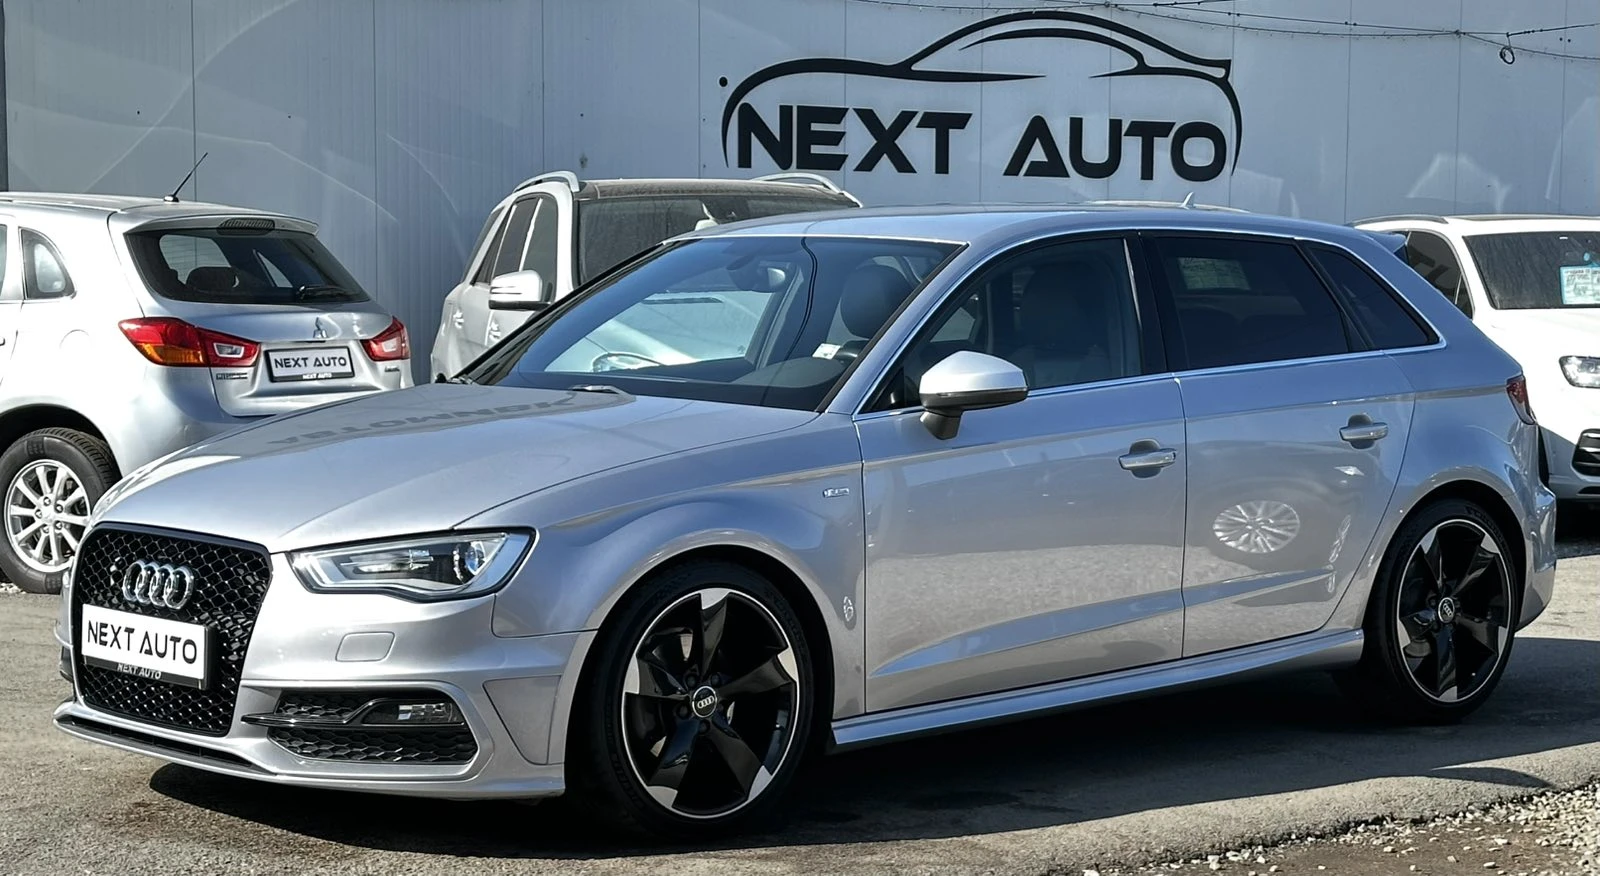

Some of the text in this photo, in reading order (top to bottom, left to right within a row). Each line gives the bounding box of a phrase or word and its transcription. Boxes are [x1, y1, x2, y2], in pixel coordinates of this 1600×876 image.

[737, 102, 1228, 182] NEXT AUTO
[274, 356, 347, 369] NEXT AUTO
[87, 619, 198, 664] NEXT AUTO
[117, 663, 162, 680] NEXT AUTO
